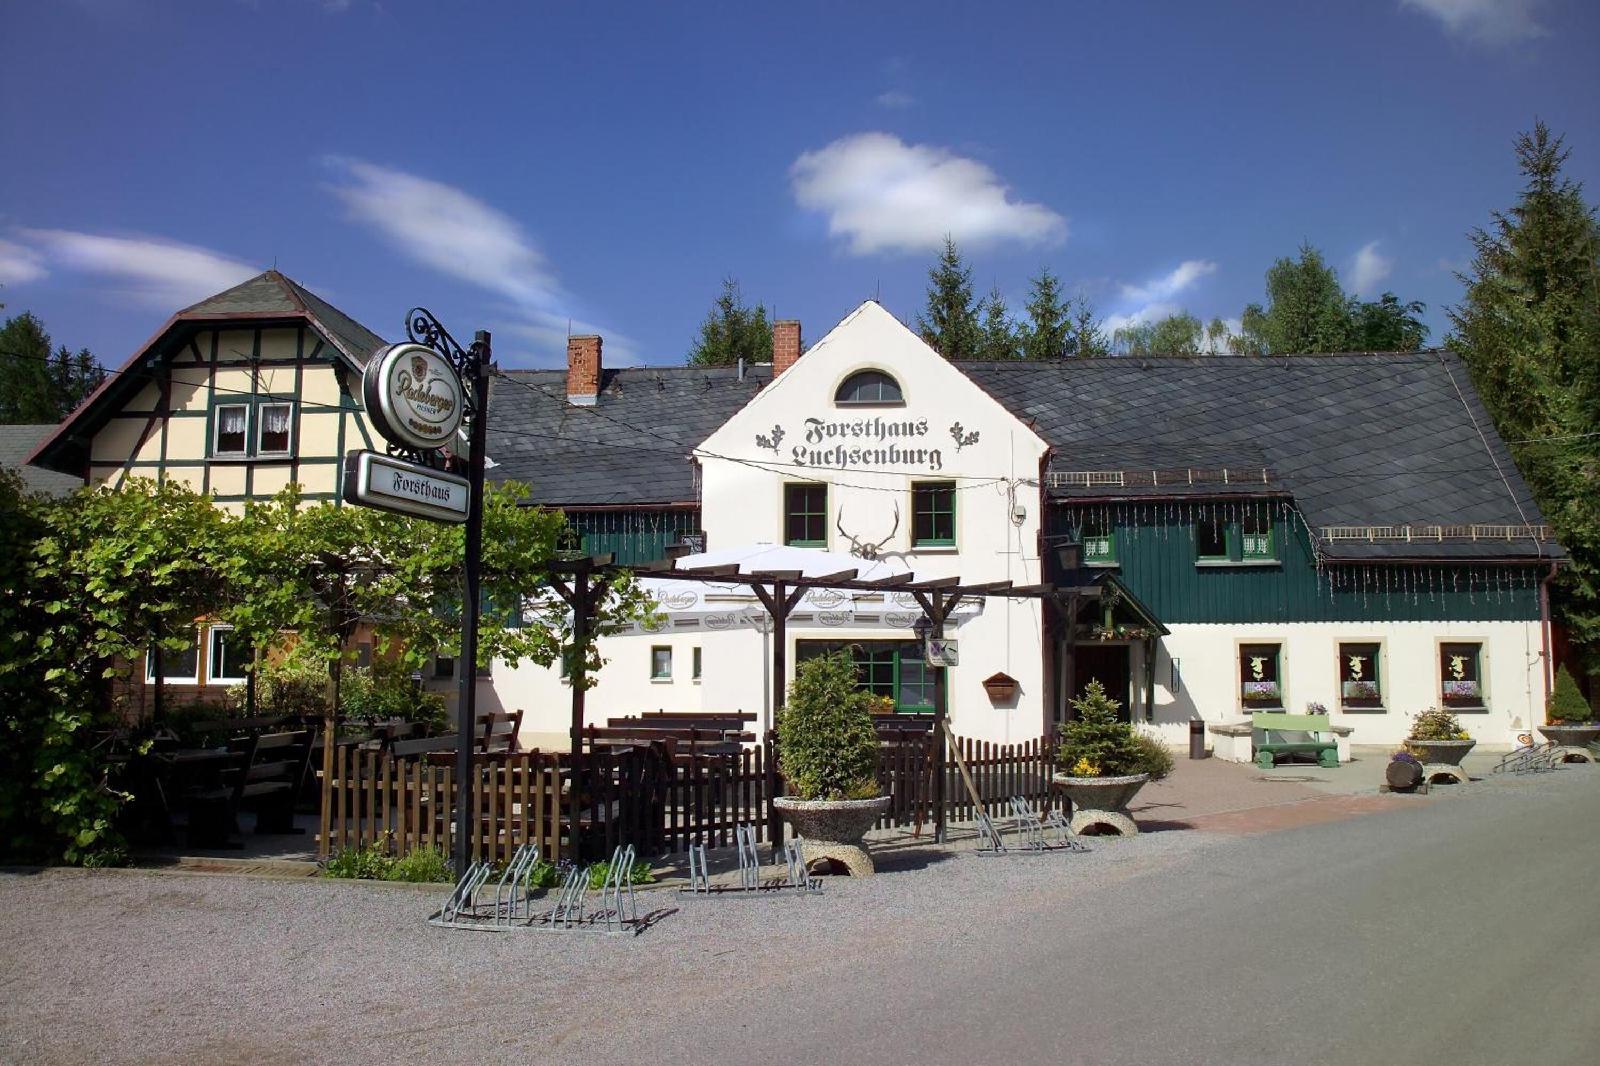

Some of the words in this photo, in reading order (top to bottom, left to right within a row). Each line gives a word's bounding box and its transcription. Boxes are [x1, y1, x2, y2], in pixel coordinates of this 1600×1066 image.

[395, 369, 454, 413] Radeberger
[804, 416, 930, 444] Forsthaus
[792, 443, 943, 471] Luchsenburg
[393, 471, 451, 501] Forsthaus
